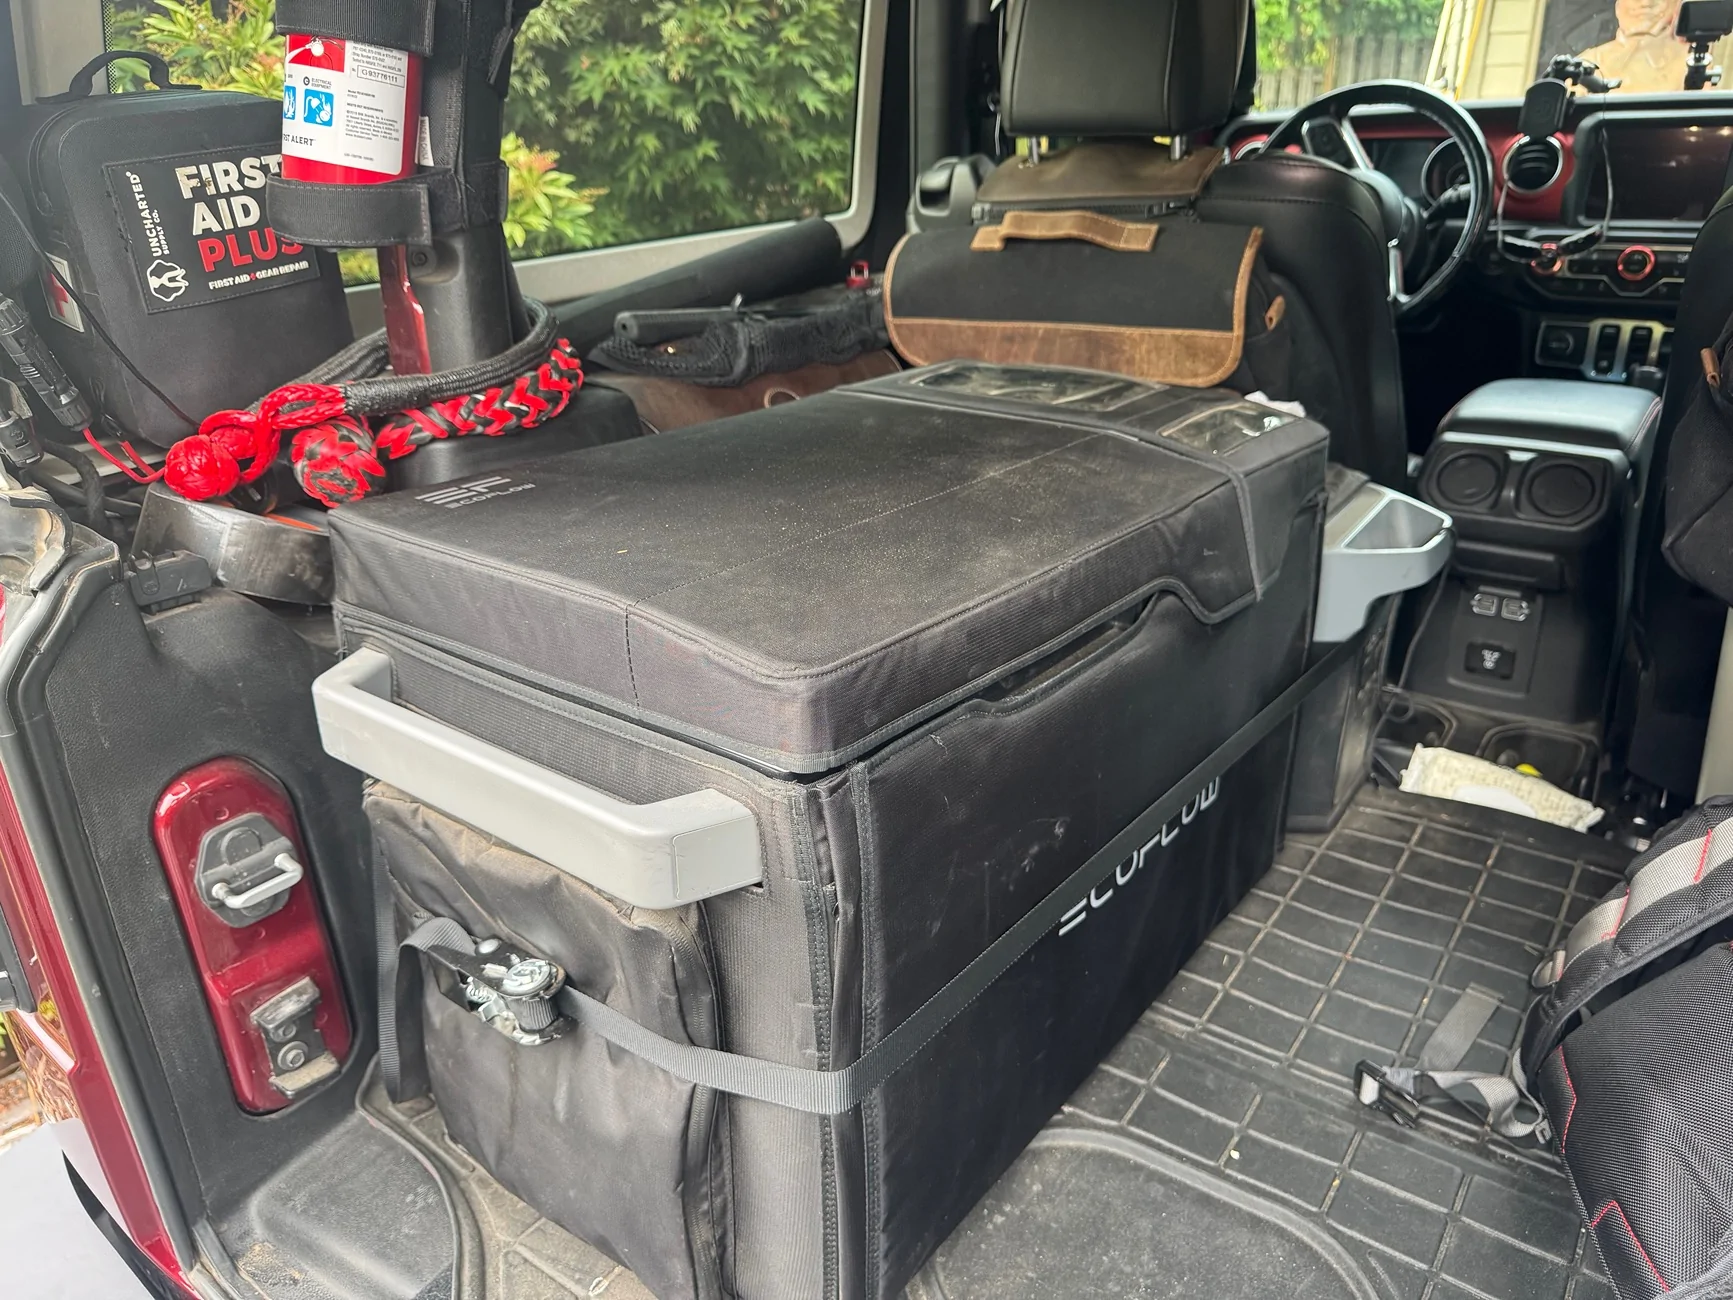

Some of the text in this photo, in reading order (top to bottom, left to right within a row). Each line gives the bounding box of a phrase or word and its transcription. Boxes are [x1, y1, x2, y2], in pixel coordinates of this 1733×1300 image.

[291, 135, 314, 146] ALERT
[175, 154, 282, 199] FIRST
[192, 195, 261, 236] AID
[156, 225, 170, 255] SUPPLY
[208, 260, 309, 290] FIRST AID GEAR REPAIR
